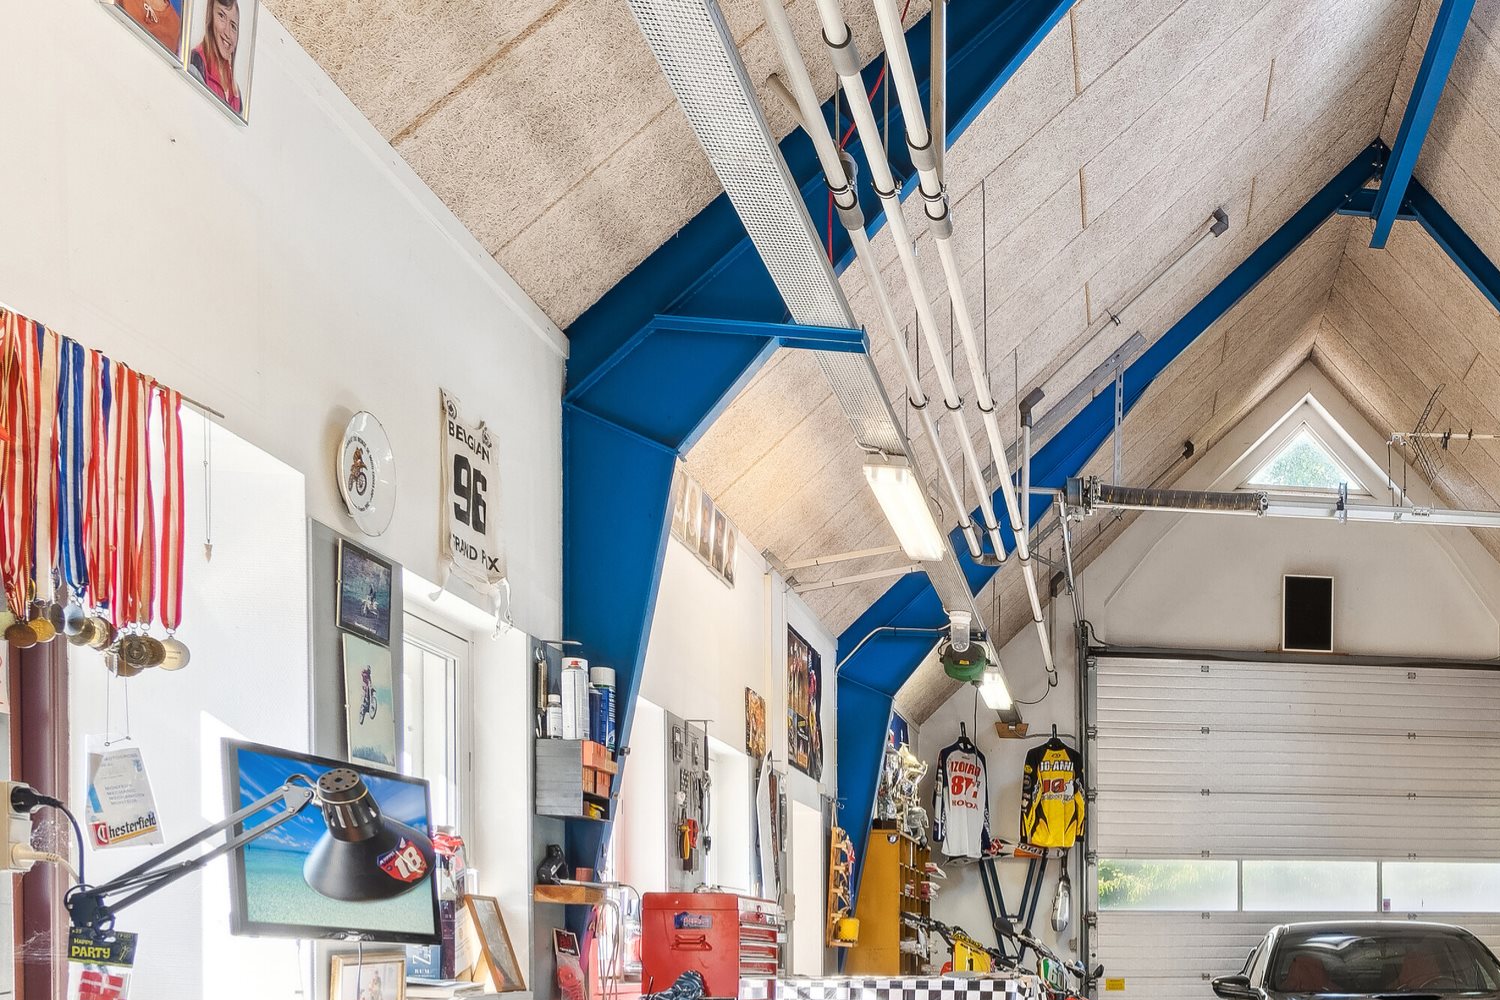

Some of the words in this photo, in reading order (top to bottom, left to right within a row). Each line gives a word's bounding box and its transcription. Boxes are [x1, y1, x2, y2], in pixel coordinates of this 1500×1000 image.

[448, 419, 490, 464] BELGIAN
[453, 453, 487, 535] 96
[97, 813, 157, 845] Chesterfield
[71, 946, 110, 958] PARTY
